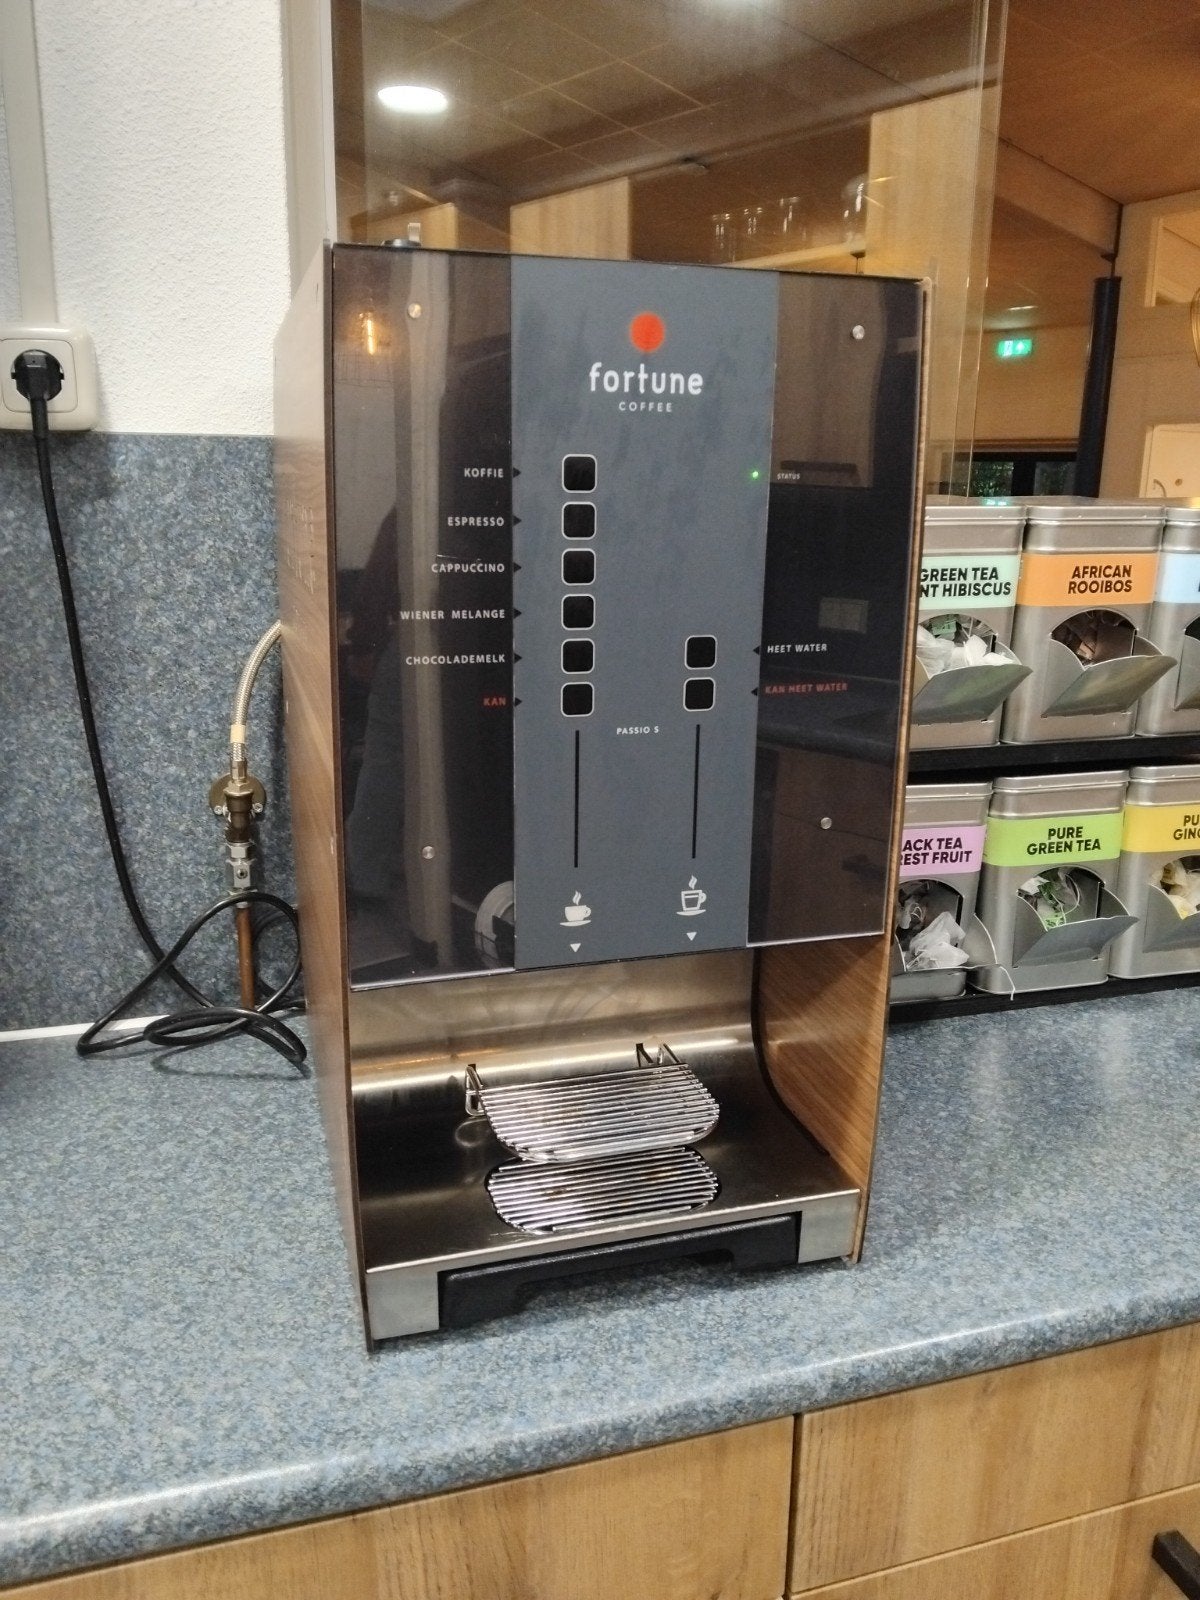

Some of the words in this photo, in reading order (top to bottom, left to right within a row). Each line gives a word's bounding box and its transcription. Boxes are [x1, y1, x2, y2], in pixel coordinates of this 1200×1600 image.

[589, 361, 704, 396] fortune
[618, 401, 673, 413] COFFEE
[464, 468, 505, 478] KOFFIE
[777, 472, 801, 480] STATUS
[447, 517, 505, 527] ESPRESSO
[431, 563, 505, 573] CAPPUCCINO
[1071, 565, 1133, 579] AFRICAN
[921, 567, 968, 582] GREEN
[972, 567, 999, 580] TEA
[942, 582, 1012, 597] HIBISCUS
[1068, 579, 1133, 594] ROOIBOS
[400, 611, 445, 620] WIENER
[452, 609, 506, 619] MELANGE
[767, 645, 792, 653] HEET
[795, 643, 828, 652] WATER
[406, 654, 506, 665] CHOCOLADEMELK
[765, 686, 786, 694] KAN
[788, 684, 813, 692] HEET
[816, 683, 849, 692] WATER
[483, 697, 507, 706] KAN
[616, 726, 651, 735] PASSIO
[653, 725, 660, 734] S
[1048, 827, 1083, 840] PURE
[936, 837, 963, 850] TEA
[1026, 842, 1073, 855] GREEN
[1076, 838, 1102, 851] TEA
[932, 850, 973, 864] FRUIT
